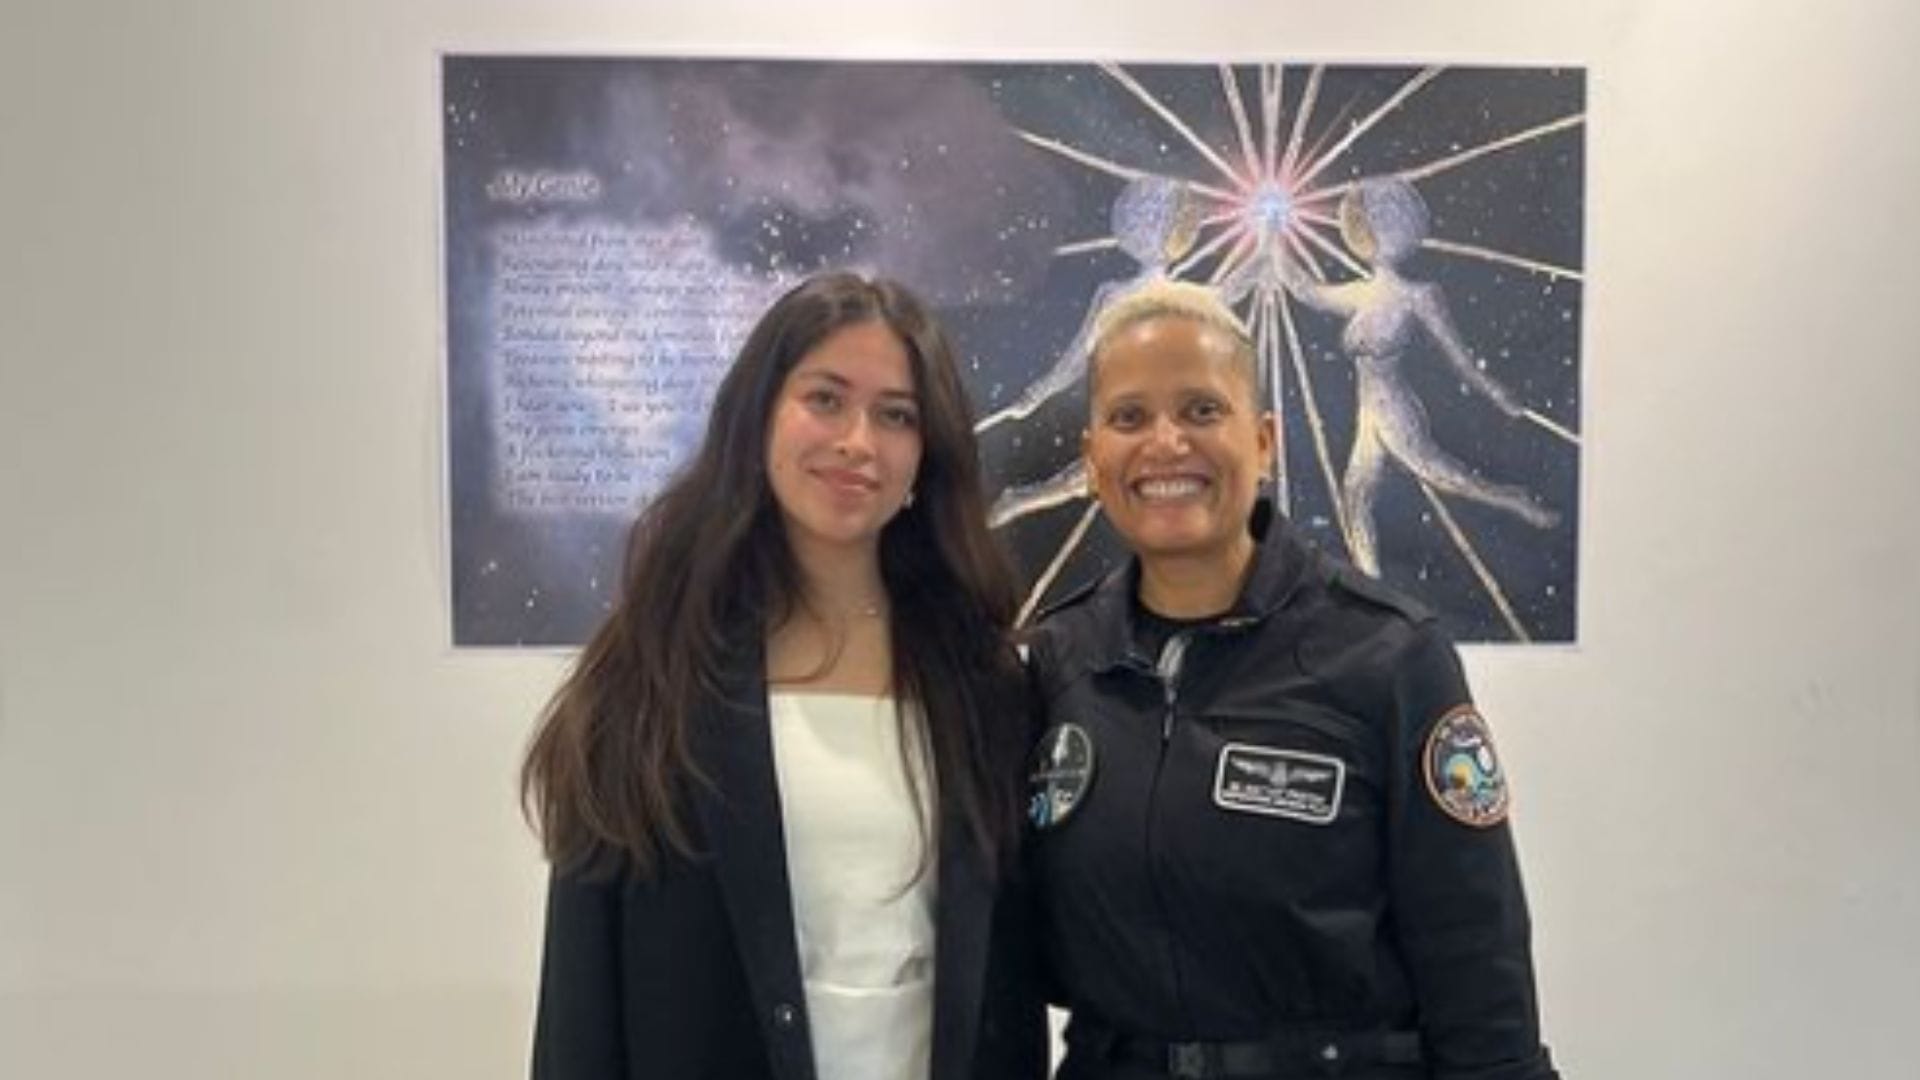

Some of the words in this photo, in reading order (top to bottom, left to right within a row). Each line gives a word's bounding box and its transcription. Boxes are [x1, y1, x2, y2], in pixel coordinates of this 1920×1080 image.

[588, 232, 628, 250] from
[594, 256, 623, 276] day
[638, 353, 654, 365] to
[658, 351, 676, 365] be
[645, 401, 677, 418] you
